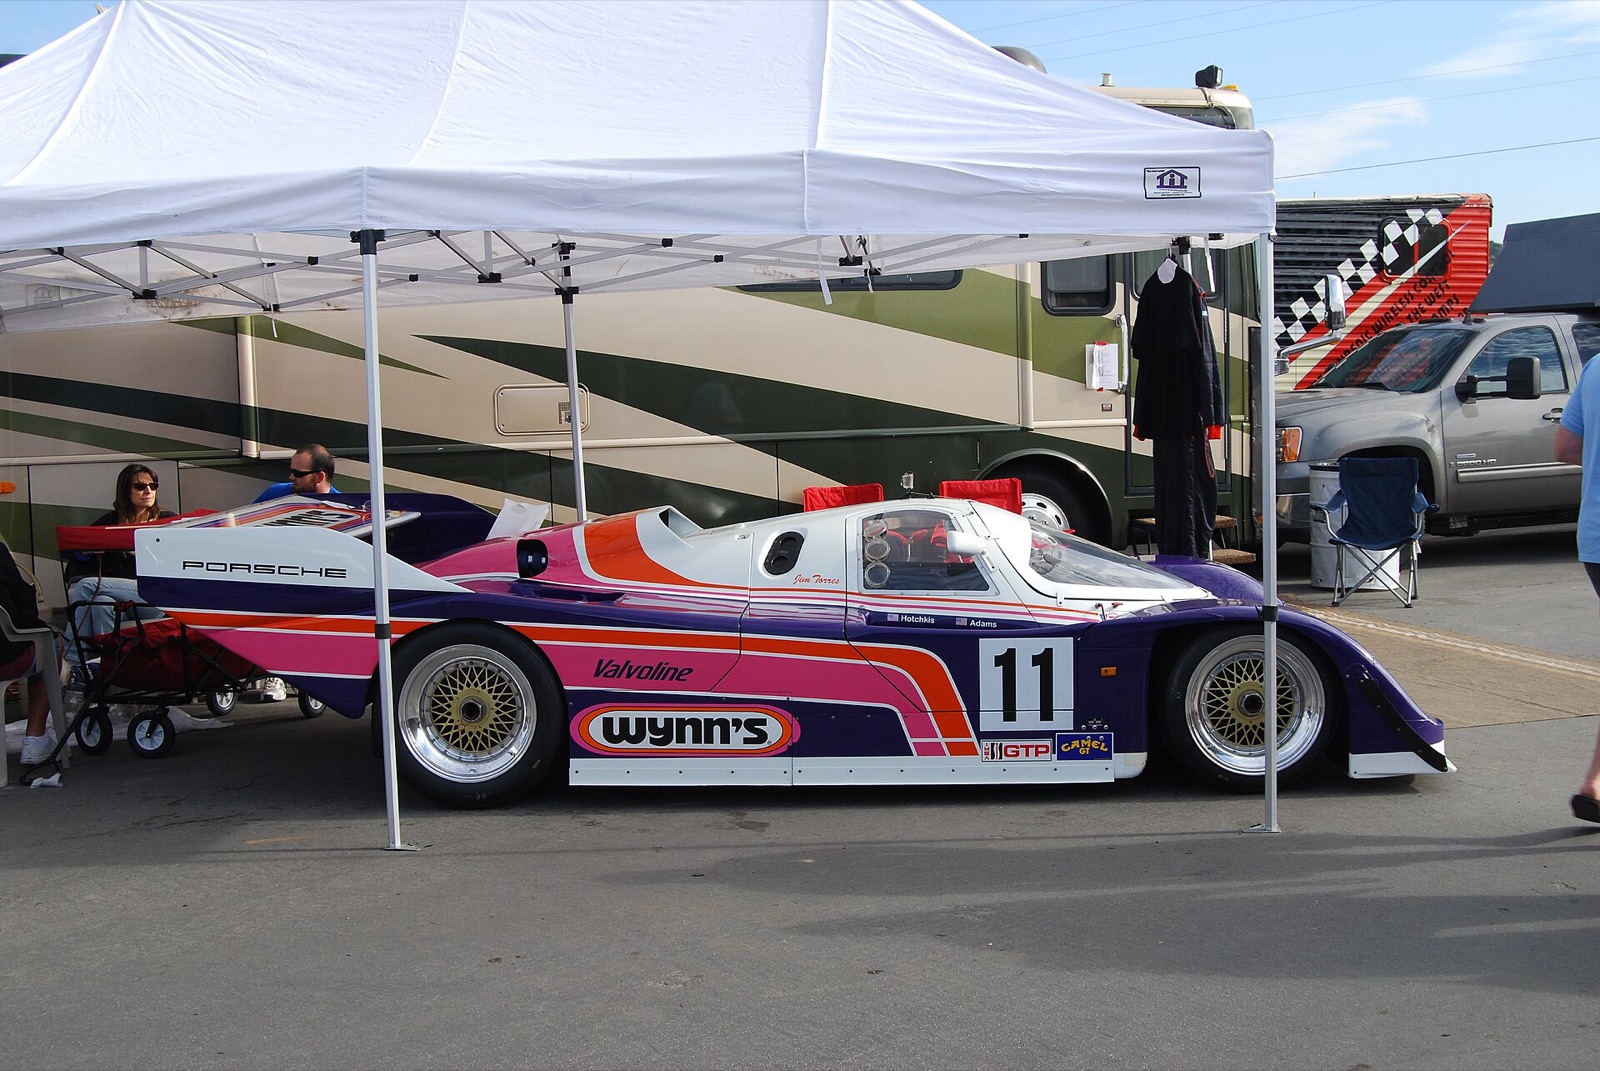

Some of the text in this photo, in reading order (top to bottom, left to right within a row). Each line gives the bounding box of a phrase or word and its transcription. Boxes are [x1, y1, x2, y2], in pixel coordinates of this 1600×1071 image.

[1406, 279, 1451, 323] THE WEST
[1371, 289, 1414, 334] WIRELESS
[182, 560, 348, 579] PORSCHE
[792, 573, 841, 586] Jim Torres
[900, 614, 935, 625] Hotchkis
[969, 619, 998, 629] Adams
[593, 658, 694, 682] Valvoline
[993, 647, 1055, 723] 11
[602, 716, 769, 747] wynn's
[1003, 744, 1050, 758] GTP
[1060, 739, 1109, 752] CAMEL
[1078, 747, 1091, 755] GT
